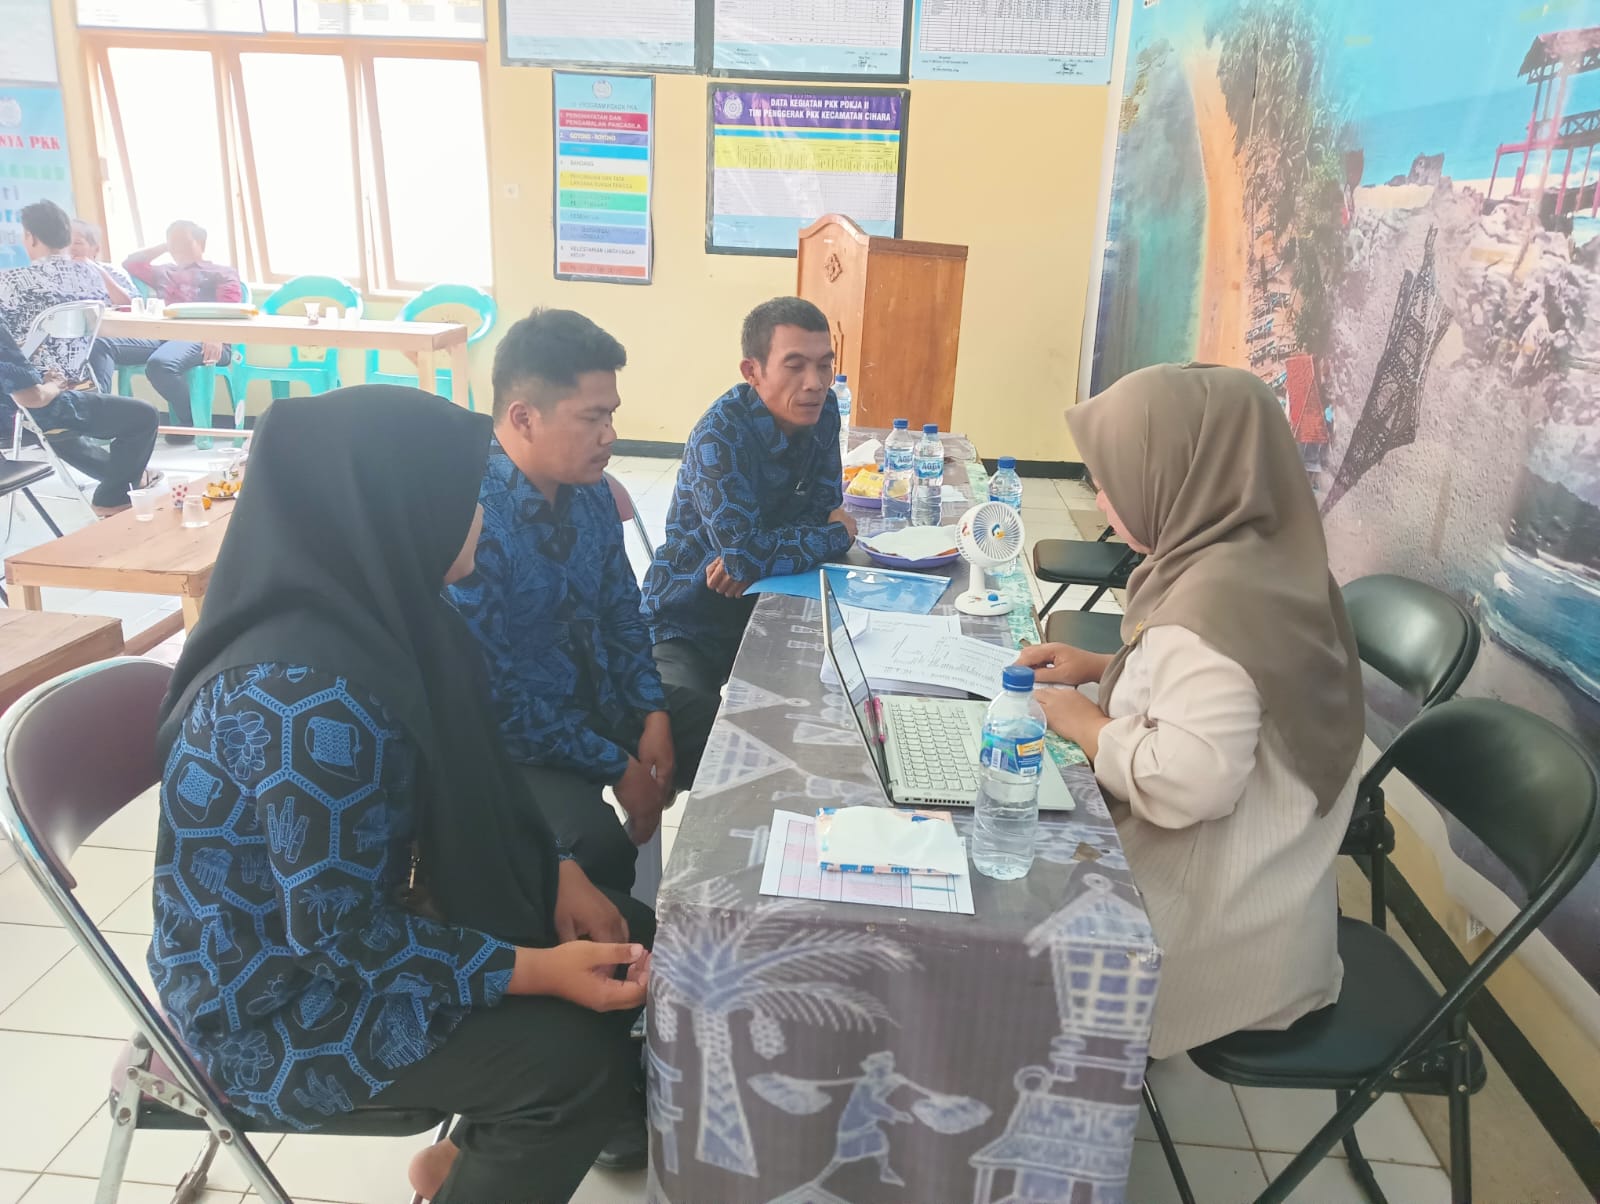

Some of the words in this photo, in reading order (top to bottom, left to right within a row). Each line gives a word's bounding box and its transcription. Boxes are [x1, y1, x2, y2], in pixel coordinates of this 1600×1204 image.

[770, 98, 788, 107] DATA
[790, 99, 823, 108] KEGIATAN
[824, 100, 839, 109] PKK
[840, 100, 863, 109] POKJA
[749, 109, 762, 117] TIM
[763, 109, 804, 119] PENGGERAK
[806, 110, 820, 119] PKK
[821, 111, 863, 121] KECAMATAN
[864, 112, 891, 121] CIHARA
[29, 135, 61, 151] PKK
